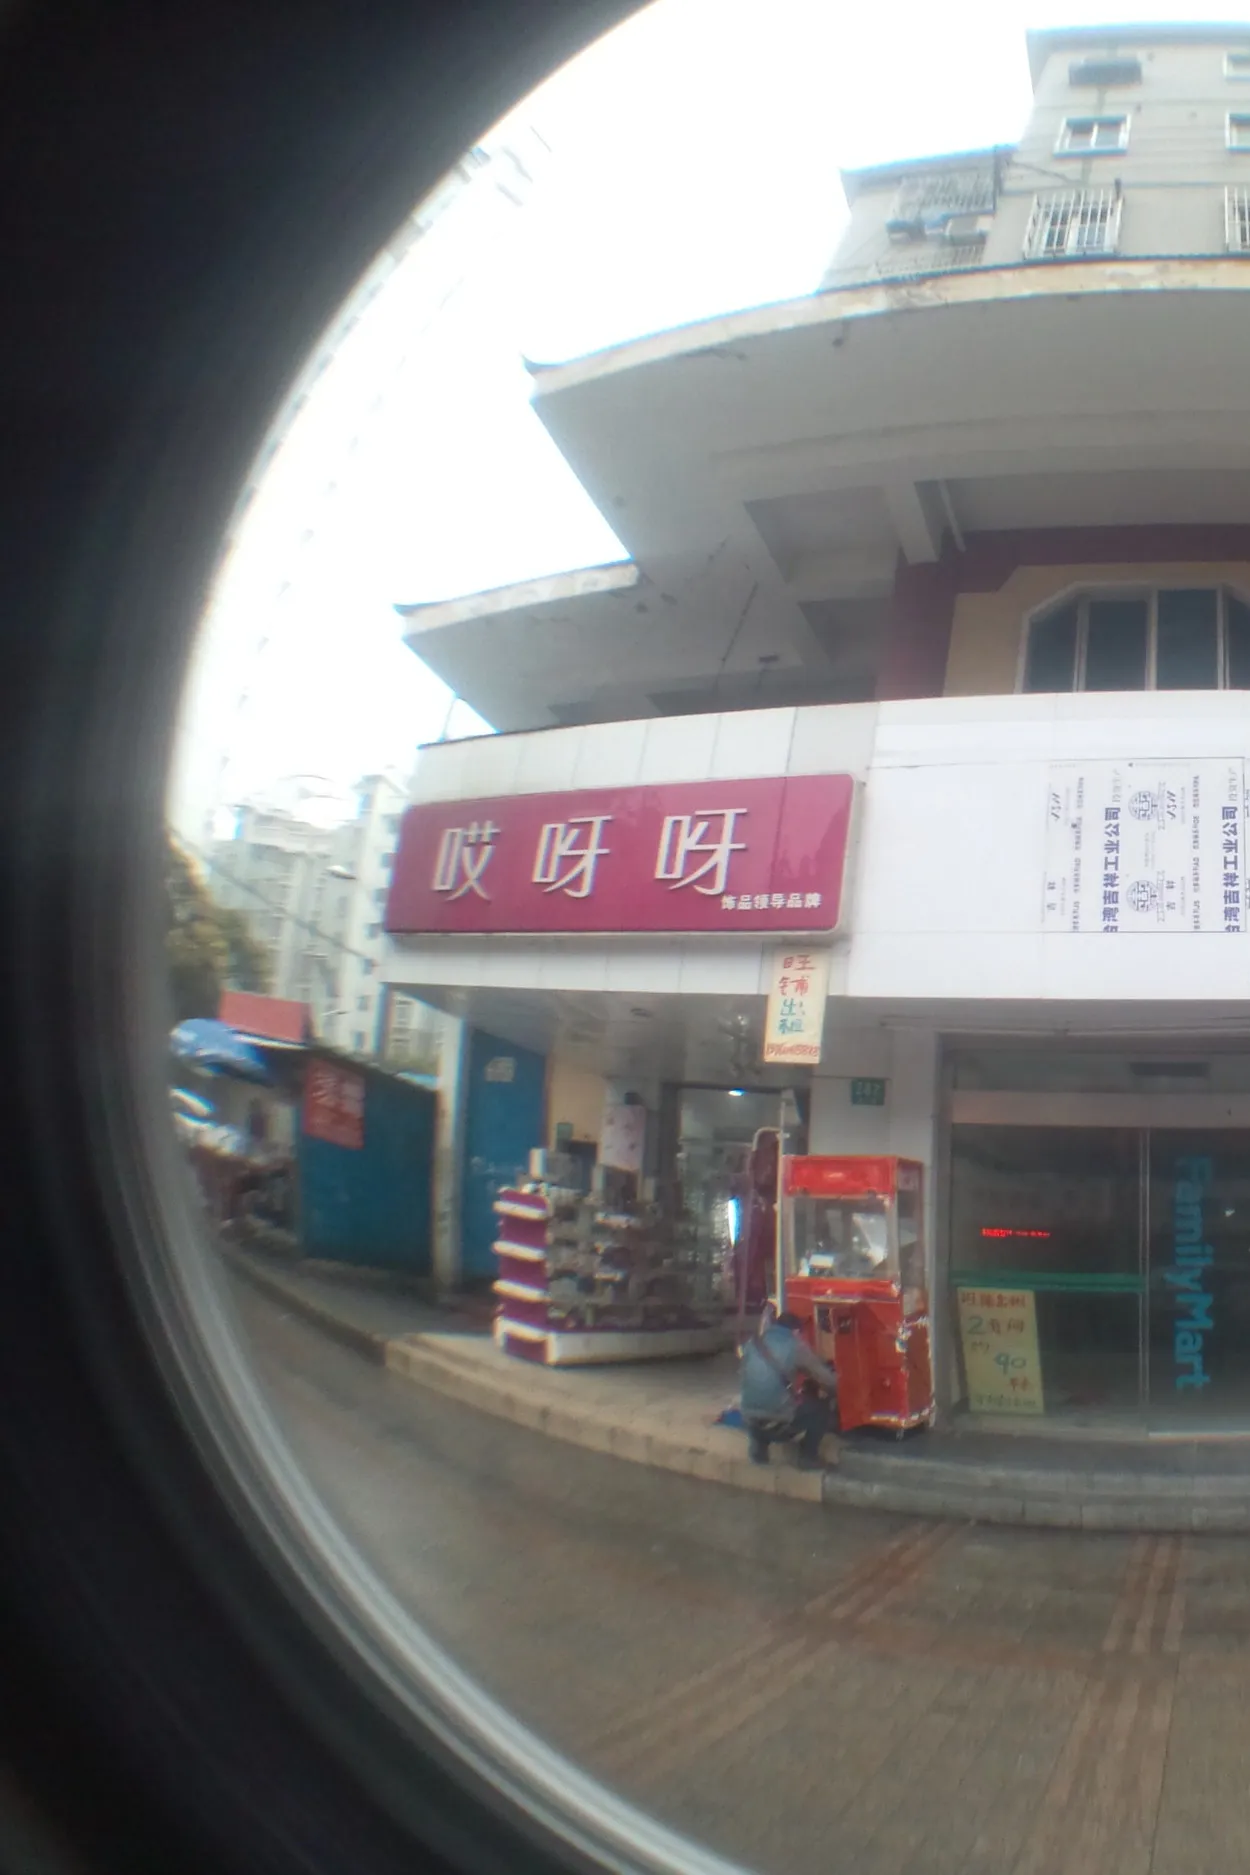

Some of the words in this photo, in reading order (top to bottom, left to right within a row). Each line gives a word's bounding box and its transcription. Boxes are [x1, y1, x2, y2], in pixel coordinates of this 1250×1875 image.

[432, 807, 749, 901] 哎呀呀
[1163, 1156, 1214, 1389] FamilyMart
